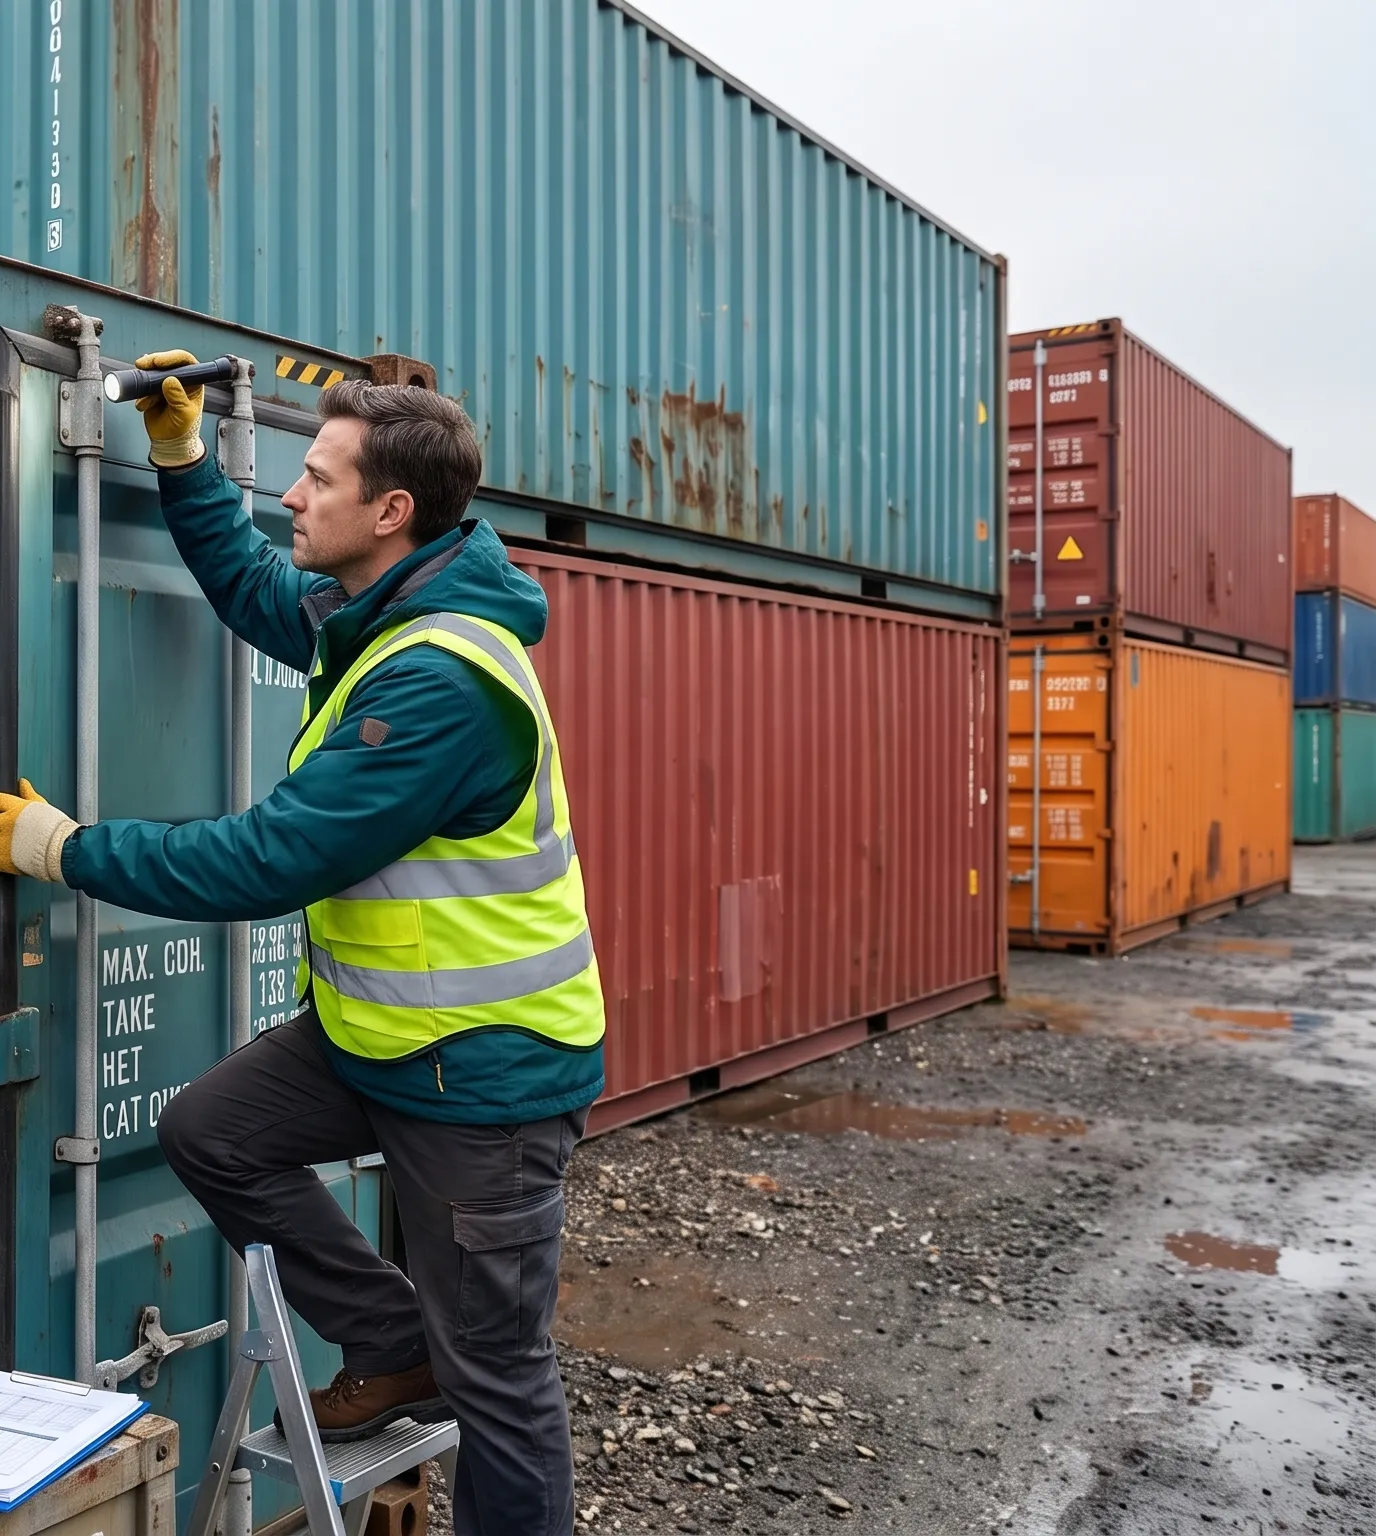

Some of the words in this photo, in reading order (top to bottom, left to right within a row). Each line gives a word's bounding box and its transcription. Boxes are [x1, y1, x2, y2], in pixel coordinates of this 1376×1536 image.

[103, 943, 154, 987] MAX.
[102, 993, 156, 1038] TAKE
[103, 1045, 143, 1089] HET
[103, 1094, 142, 1140] CAT
